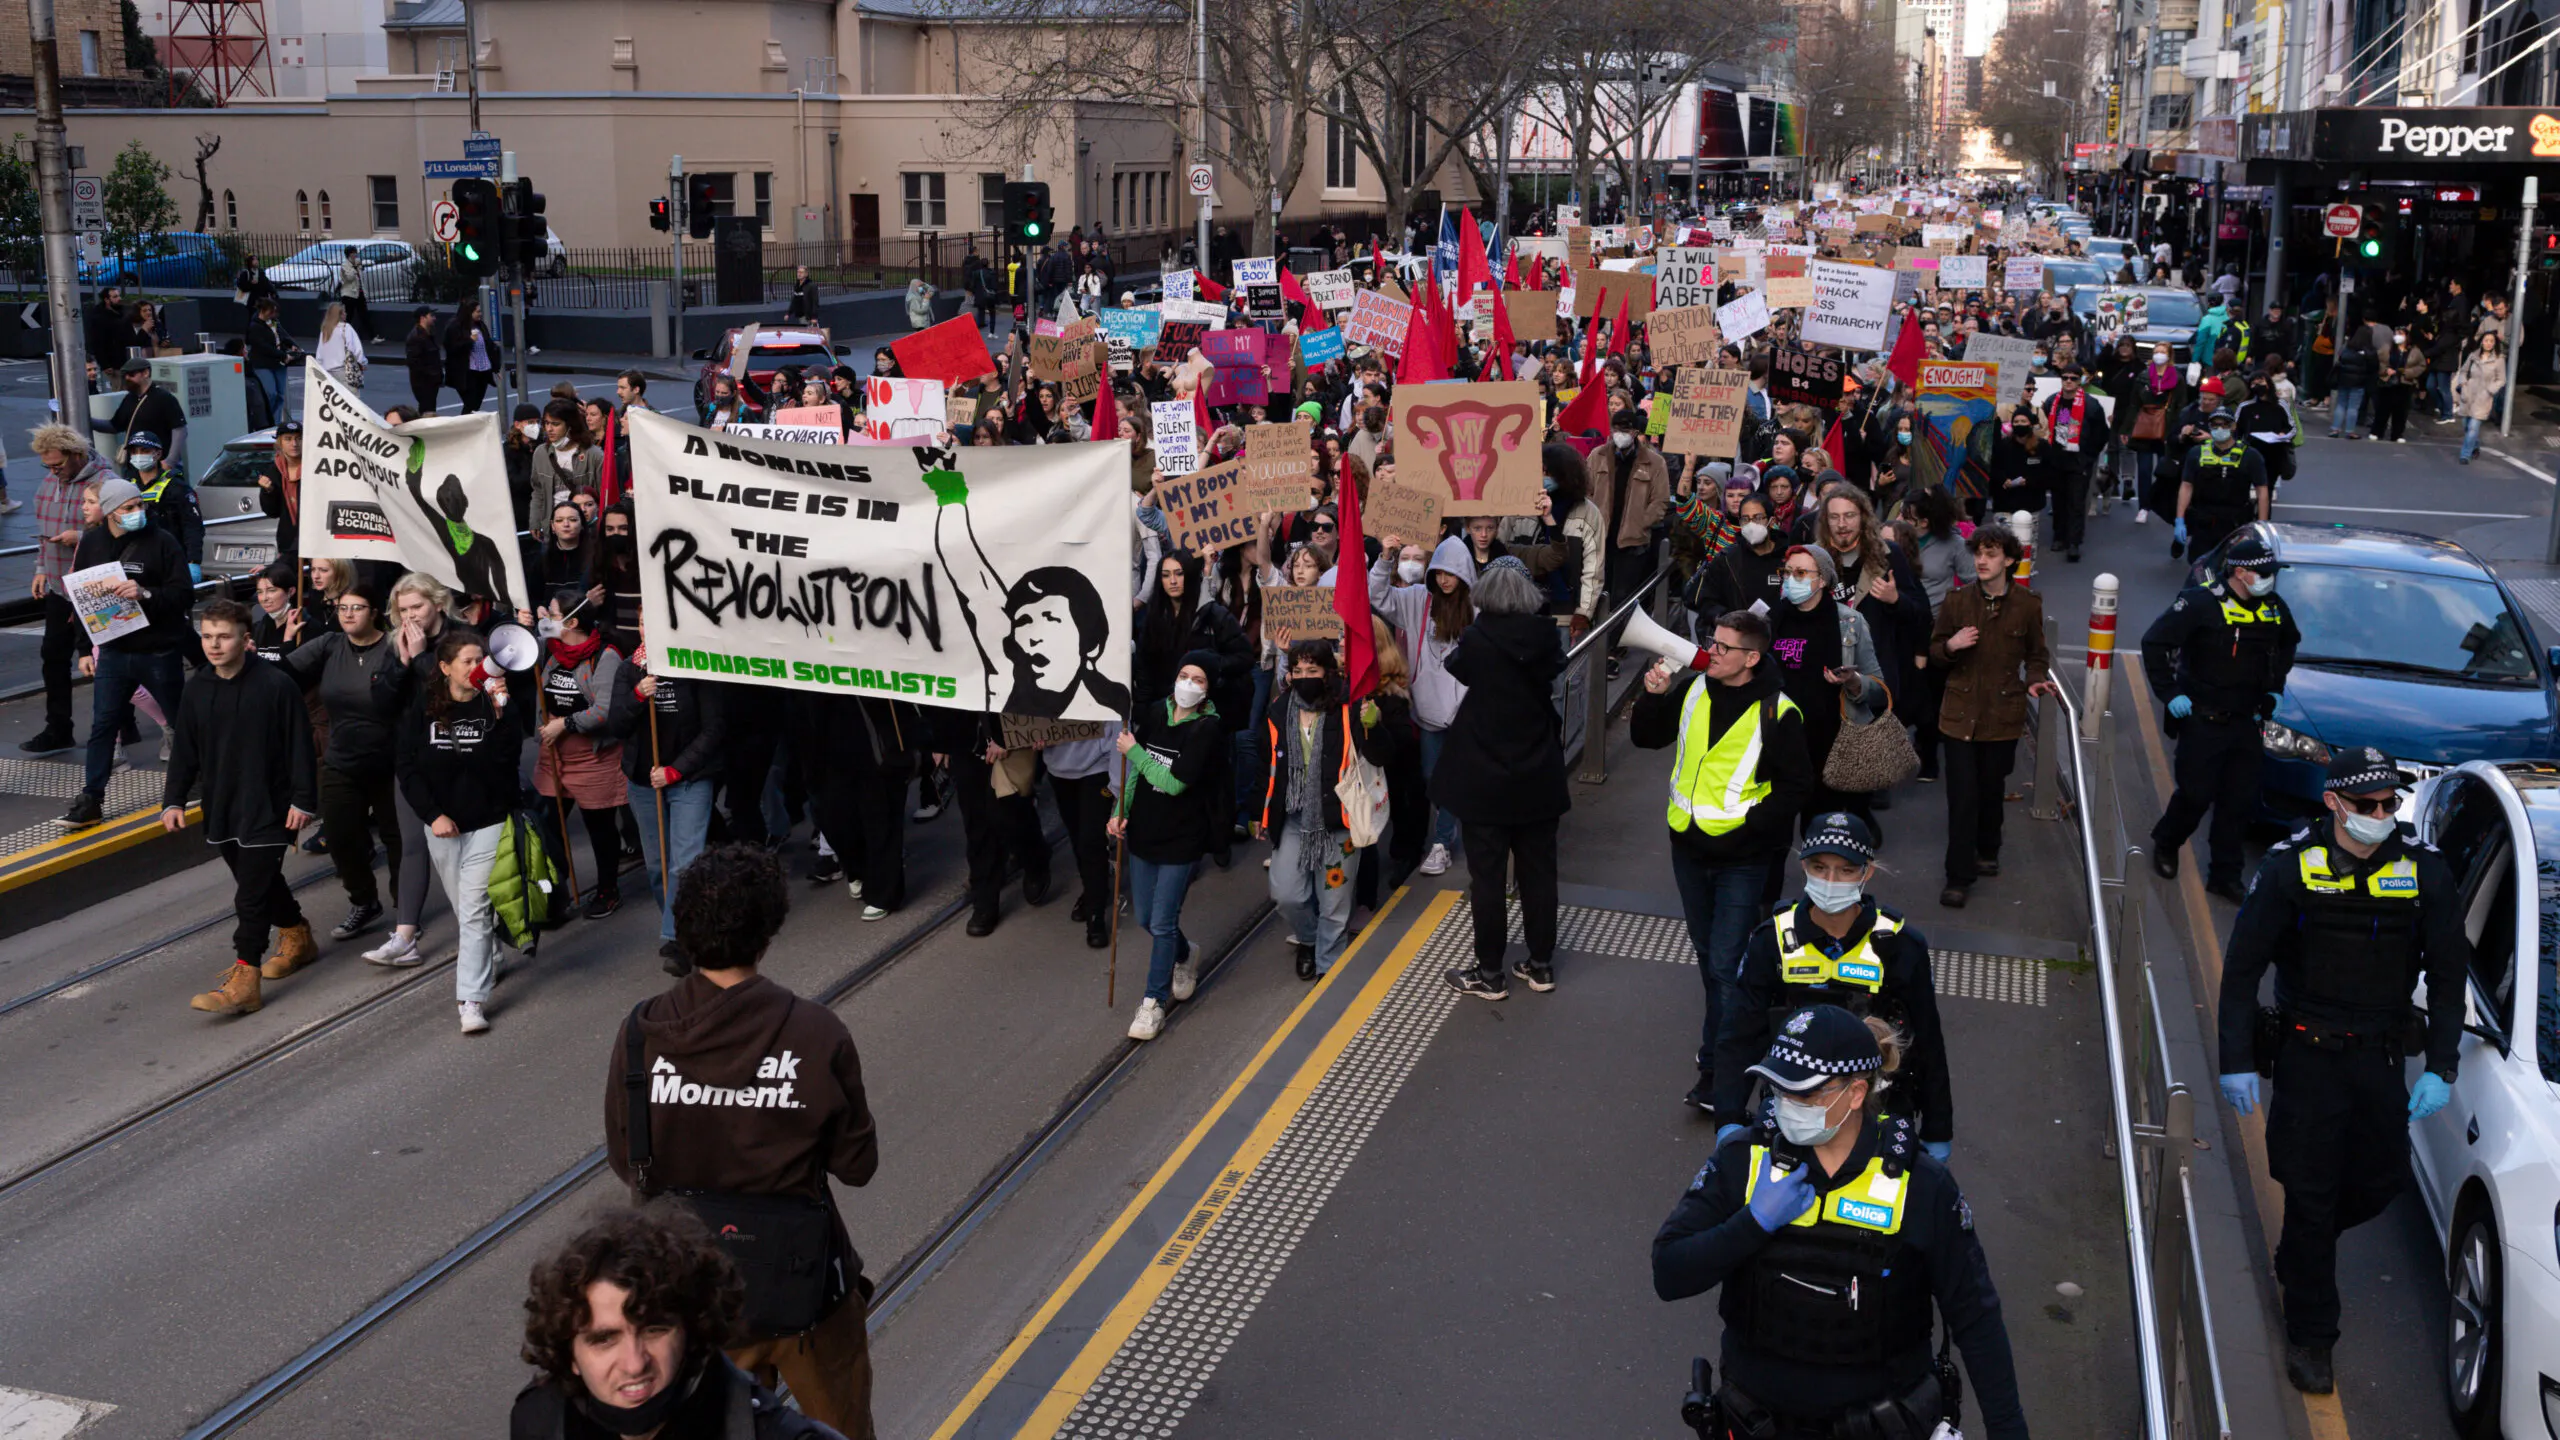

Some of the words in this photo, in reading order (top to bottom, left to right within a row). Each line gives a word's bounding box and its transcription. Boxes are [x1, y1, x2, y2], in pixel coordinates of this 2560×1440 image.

[2378, 118, 2514, 157] Pepper
[434, 164, 442, 172] Lt
[444, 162, 485, 172] Lonsdale
[487, 161, 498, 171] St
[1193, 174, 1210, 185] 40
[79, 186, 92, 195] 20
[1233, 261, 1245, 270] WE
[1249, 259, 1274, 270] WANT
[1666, 250, 1676, 262] I
[1684, 251, 1715, 265] WILL
[1943, 257, 1968, 271] GOD
[1242, 271, 1270, 281] BODY
[1323, 271, 1352, 287] STAND
[1660, 267, 1698, 285] AID
[1700, 265, 1715, 286] &
[1844, 277, 1855, 285] for
[1313, 288, 1353, 303] TOGETHER
[1658, 286, 1714, 307] ABET
[1815, 284, 1860, 299] WHACK
[1359, 292, 1413, 324] BANNIN
[1812, 299, 1836, 310] ASS
[1352, 309, 1408, 339] ABORTIO
[1649, 307, 1712, 335] ABORTION
[1808, 311, 1883, 331] PATRIARCHY
[2098, 314, 2117, 332] NO
[1064, 320, 1094, 341] GIRLS
[1164, 321, 1203, 341] FUCK
[1307, 331, 1336, 344] ABORTION
[1348, 324, 1366, 341] IS
[1673, 331, 1687, 346] IS
[1206, 336, 1229, 350] THIS
[1235, 335, 1251, 350] MY
[1366, 330, 1404, 354] MURD
[1062, 348, 1081, 363] HAVE
[1154, 341, 1201, 362] SCOT
[1651, 341, 1714, 365] HEALTHCARE
[1061, 360, 1080, 382] FUN
[1776, 351, 1839, 382] HOES
[1678, 369, 1696, 385] WE
[1700, 370, 1722, 385] WILL
[1724, 373, 1748, 387] NOT
[1791, 377, 1809, 389] B4
[1925, 368, 1984, 385] ENOUGH!!
[867, 377, 893, 407] NO
[1221, 385, 1225, 398] I
[1674, 385, 1689, 399] BE
[1691, 388, 1735, 400] SILENT
[1153, 402, 1167, 412] WE
[1671, 402, 1707, 418] WHILE
[1711, 405, 1739, 422] THEY
[815, 412, 834, 425] NOT
[1163, 413, 1180, 421] STAY
[867, 420, 891, 440] NO
[1157, 420, 1191, 435] SILENT
[1277, 425, 1299, 438] BABY
[1450, 418, 1487, 455] MY
[317, 431, 351, 452] AN
[341, 421, 400, 458] EMAND
[1158, 435, 1173, 444] WHILE
[1175, 434, 1191, 443] OTHER
[683, 436, 709, 456] A
[713, 440, 872, 483] WOMANS
[1162, 446, 1188, 455] WOMEN
[1248, 461, 1277, 480] YOU
[1277, 461, 1308, 477] COULD
[1454, 456, 1482, 480] BODY
[668, 474, 800, 512] PLACE
[805, 494, 849, 517] IS
[856, 498, 900, 522] IN
[1163, 482, 1192, 512] MY
[1196, 468, 1239, 499] BODY
[1394, 487, 1420, 502] BODY
[338, 508, 389, 525] VICTORIAN
[1190, 500, 1218, 523] MY
[1388, 506, 1422, 524] CHOICE
[337, 516, 392, 536] SOCIALISTS
[1180, 515, 1256, 552] CHOICE
[731, 527, 809, 558] THE
[1266, 603, 1312, 616] RIGHTS
[1320, 603, 1338, 615] AR
[666, 647, 788, 678] MONASH
[793, 660, 957, 698] SOCIALISTS
[1003, 721, 1101, 748] INCUBATOR
[2381, 879, 2414, 888] Police
[1842, 965, 1876, 978] Police
[651, 1075, 800, 1109] Moment.
[1157, 1242, 1188, 1267] WAIT
[1177, 1209, 1215, 1242] BEHIND
[1202, 1188, 1231, 1208] THIS
[1219, 1169, 1246, 1188] LINE
[1842, 1202, 1887, 1223] Police
